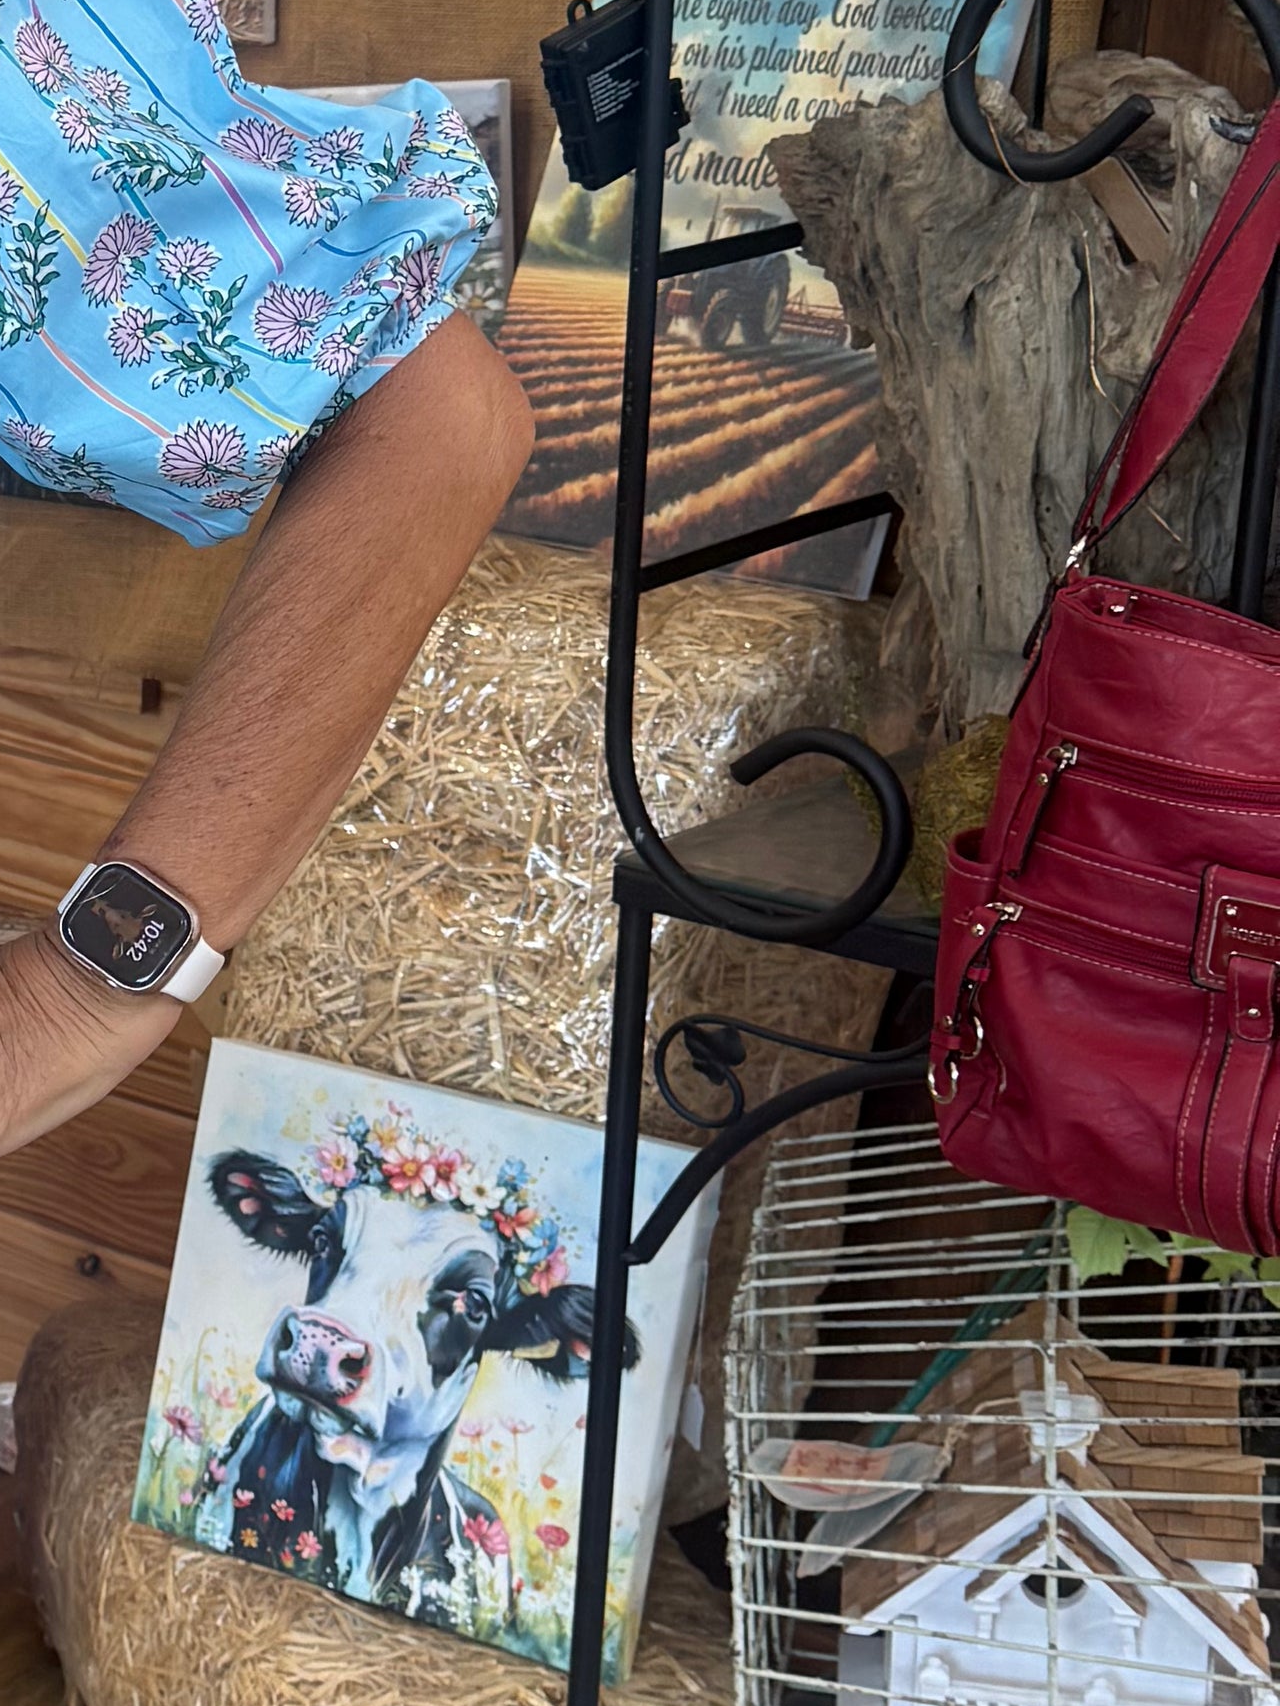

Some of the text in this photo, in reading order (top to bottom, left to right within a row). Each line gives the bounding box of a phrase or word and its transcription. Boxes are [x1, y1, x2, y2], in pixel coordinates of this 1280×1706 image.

[683, 43, 713, 68] on
[713, 35, 746, 72] his
[747, 36, 844, 87] planned
[839, 44, 944, 93] paradise
[729, 84, 785, 123] need
[784, 97, 801, 122] a
[693, 142, 778, 191] made
[125, 919, 165, 962] 10:42
